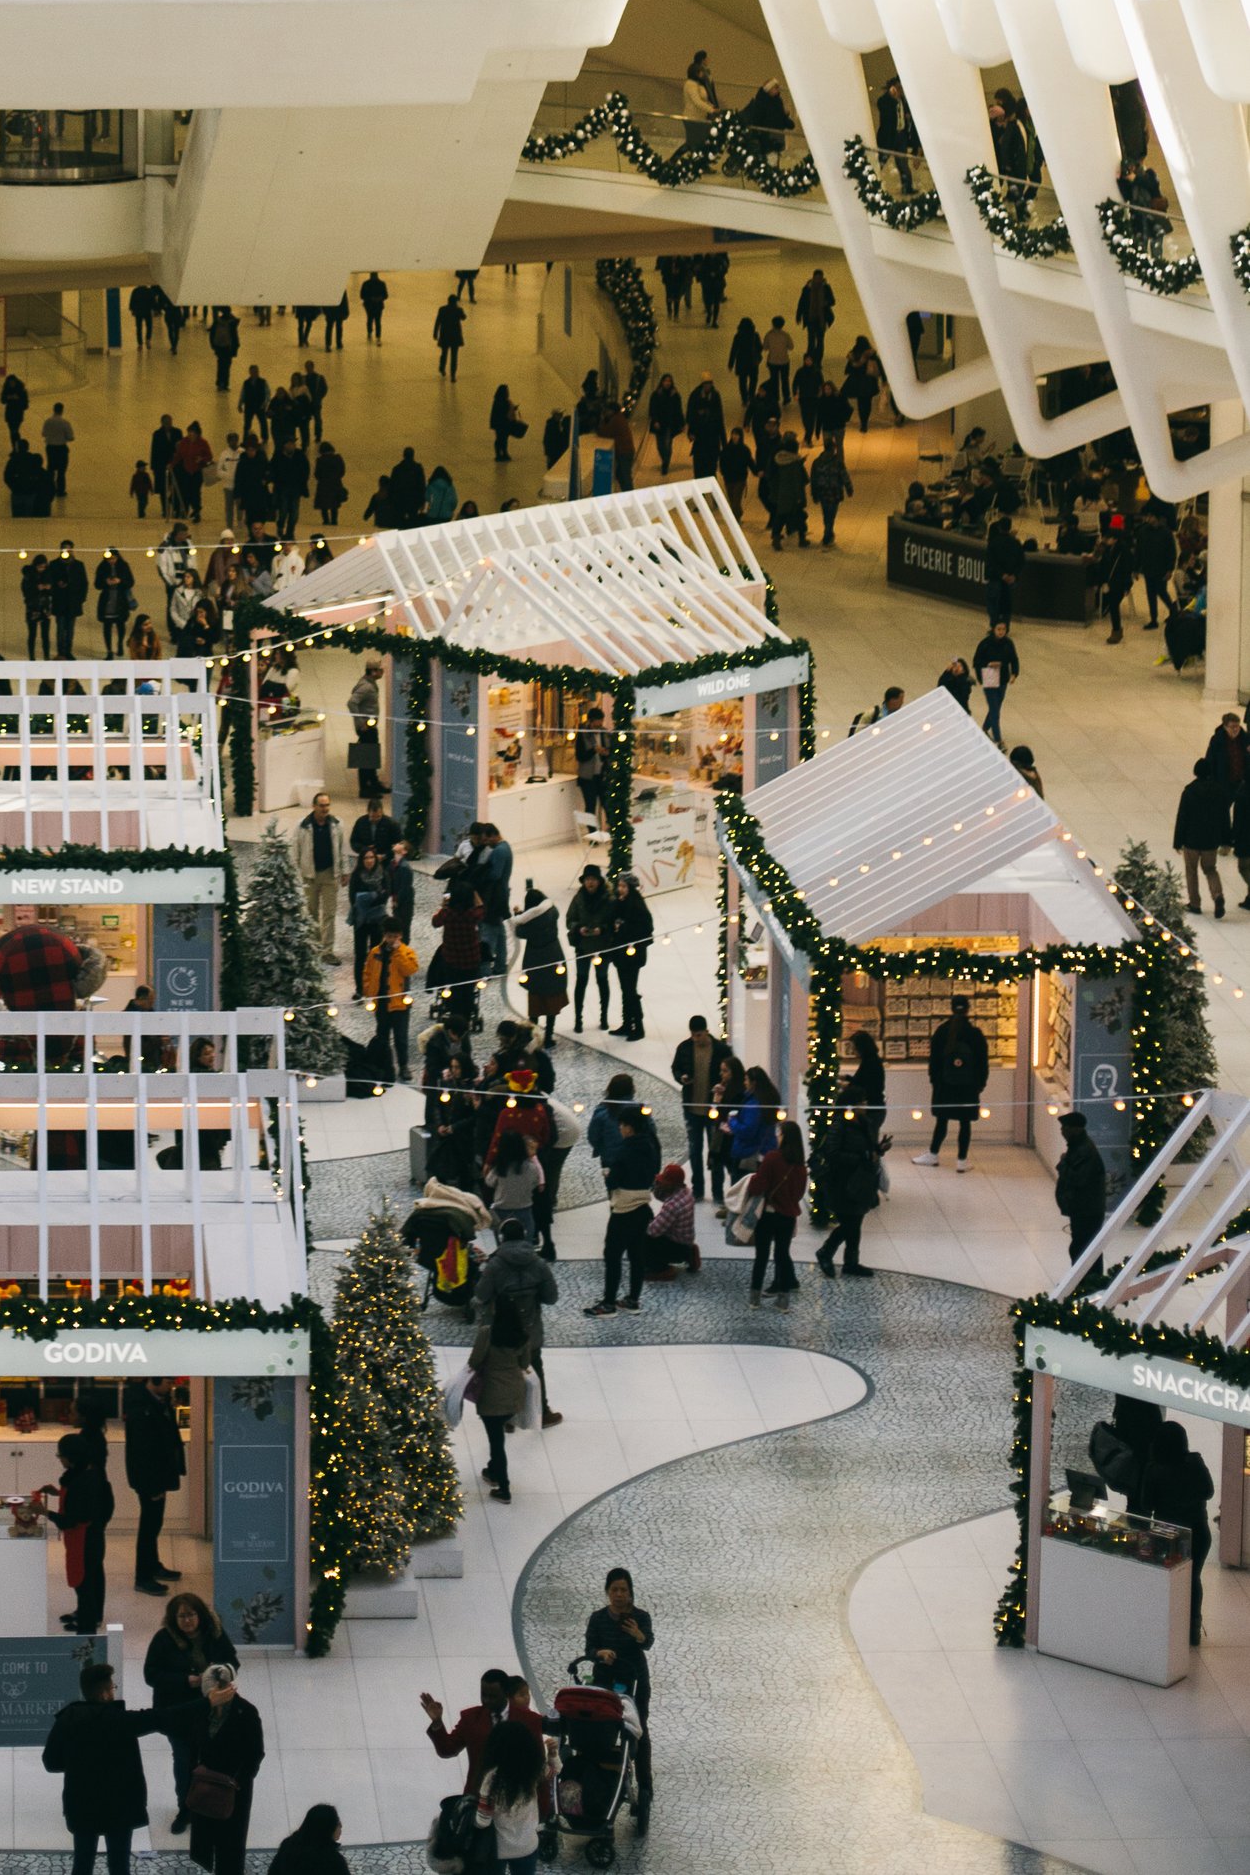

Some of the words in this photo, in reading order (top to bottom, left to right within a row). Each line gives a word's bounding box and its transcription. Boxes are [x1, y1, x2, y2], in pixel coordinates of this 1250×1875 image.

[904, 537, 953, 577] ÉPICERIE
[957, 555, 989, 585] BOUL
[697, 679, 725, 697] WILD
[726, 672, 751, 692] ONE
[12, 879, 56, 894] NEW
[60, 878, 125, 895] STAND
[44, 1342, 148, 1364] GODIVA
[224, 1481, 284, 1494] GODIVA
[36, 1661, 48, 1674] TO
[0, 1700, 66, 1716] MARKET
